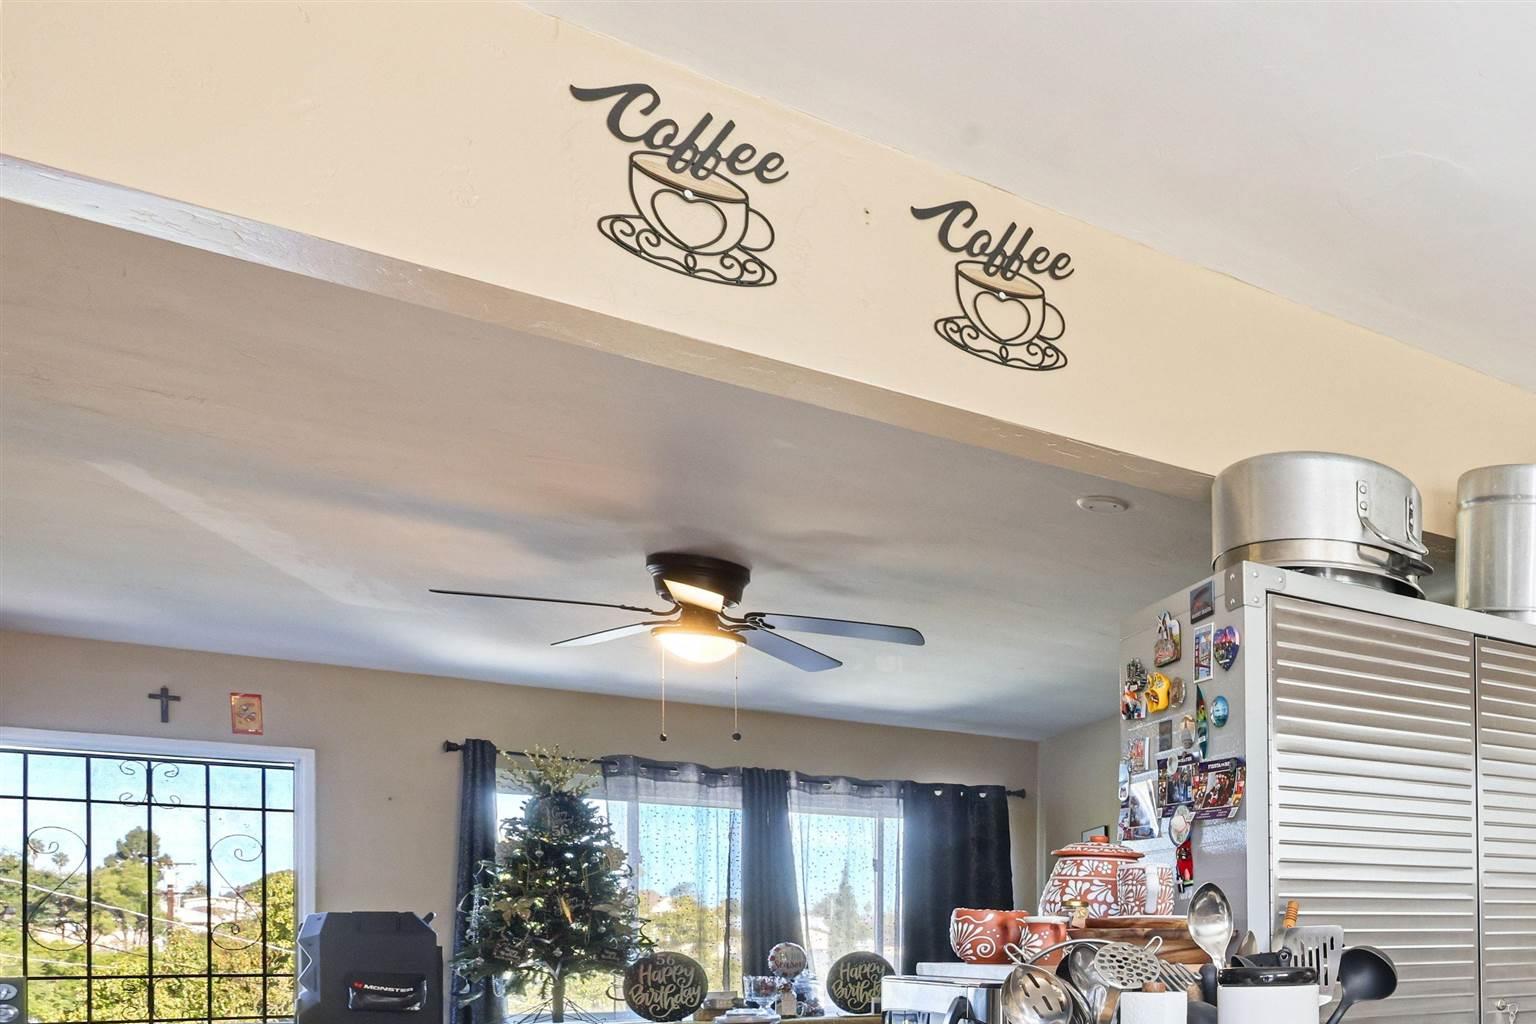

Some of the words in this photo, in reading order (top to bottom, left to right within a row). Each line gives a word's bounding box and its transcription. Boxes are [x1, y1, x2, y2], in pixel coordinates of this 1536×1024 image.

[569, 83, 789, 184] Coffee
[911, 200, 1075, 281] Coffee
[655, 955, 675, 966] 56
[839, 962, 886, 985] Happy
[363, 984, 414, 993] MONSTER
[639, 963, 695, 990] Happy
[628, 976, 701, 1017] Birthday
[831, 976, 882, 1011] Birthd
